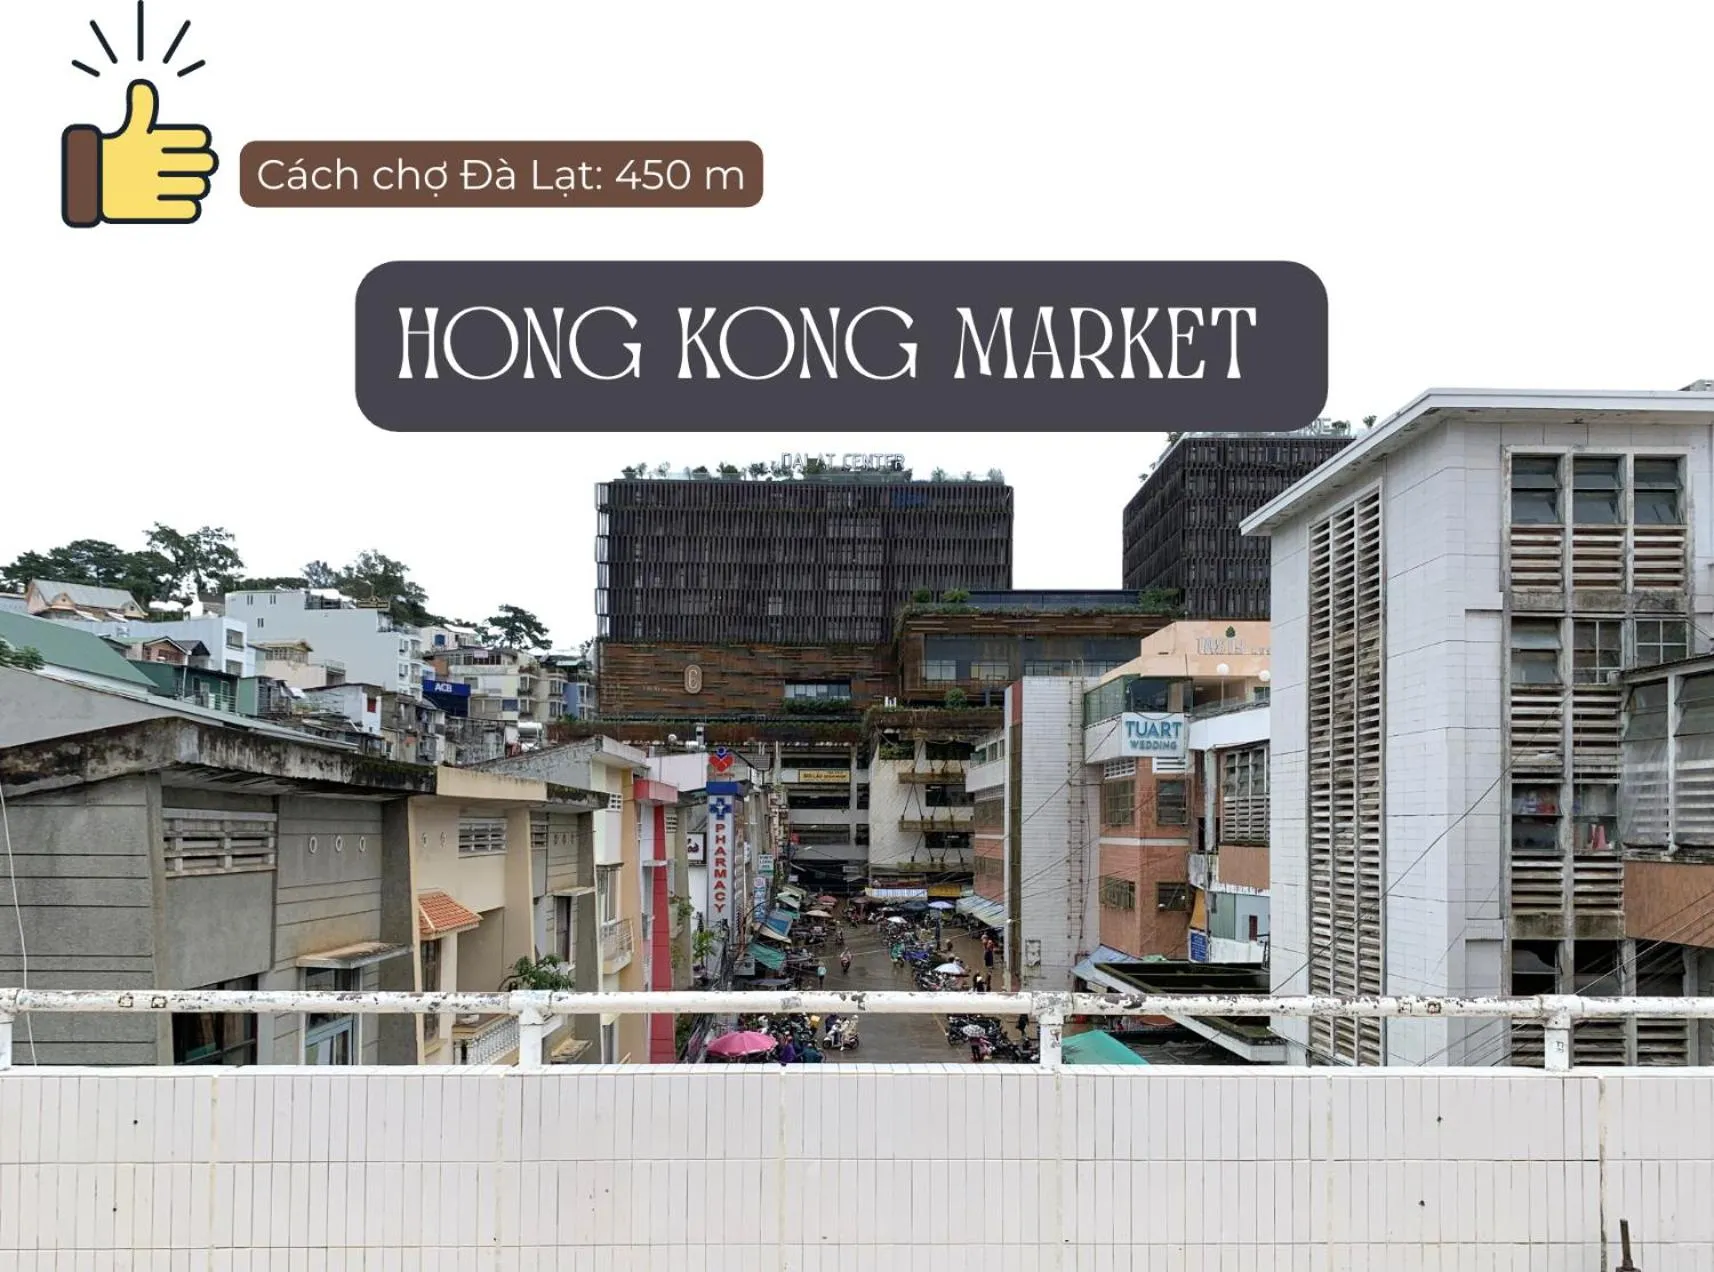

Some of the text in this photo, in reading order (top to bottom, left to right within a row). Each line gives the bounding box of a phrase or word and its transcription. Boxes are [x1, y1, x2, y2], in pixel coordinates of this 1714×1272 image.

[842, 453, 905, 471] CENTER
[434, 683, 453, 693] ACB
[1125, 721, 1182, 737] TUART
[1130, 740, 1177, 750] WEDDING
[714, 823, 727, 914] PHARMACY
